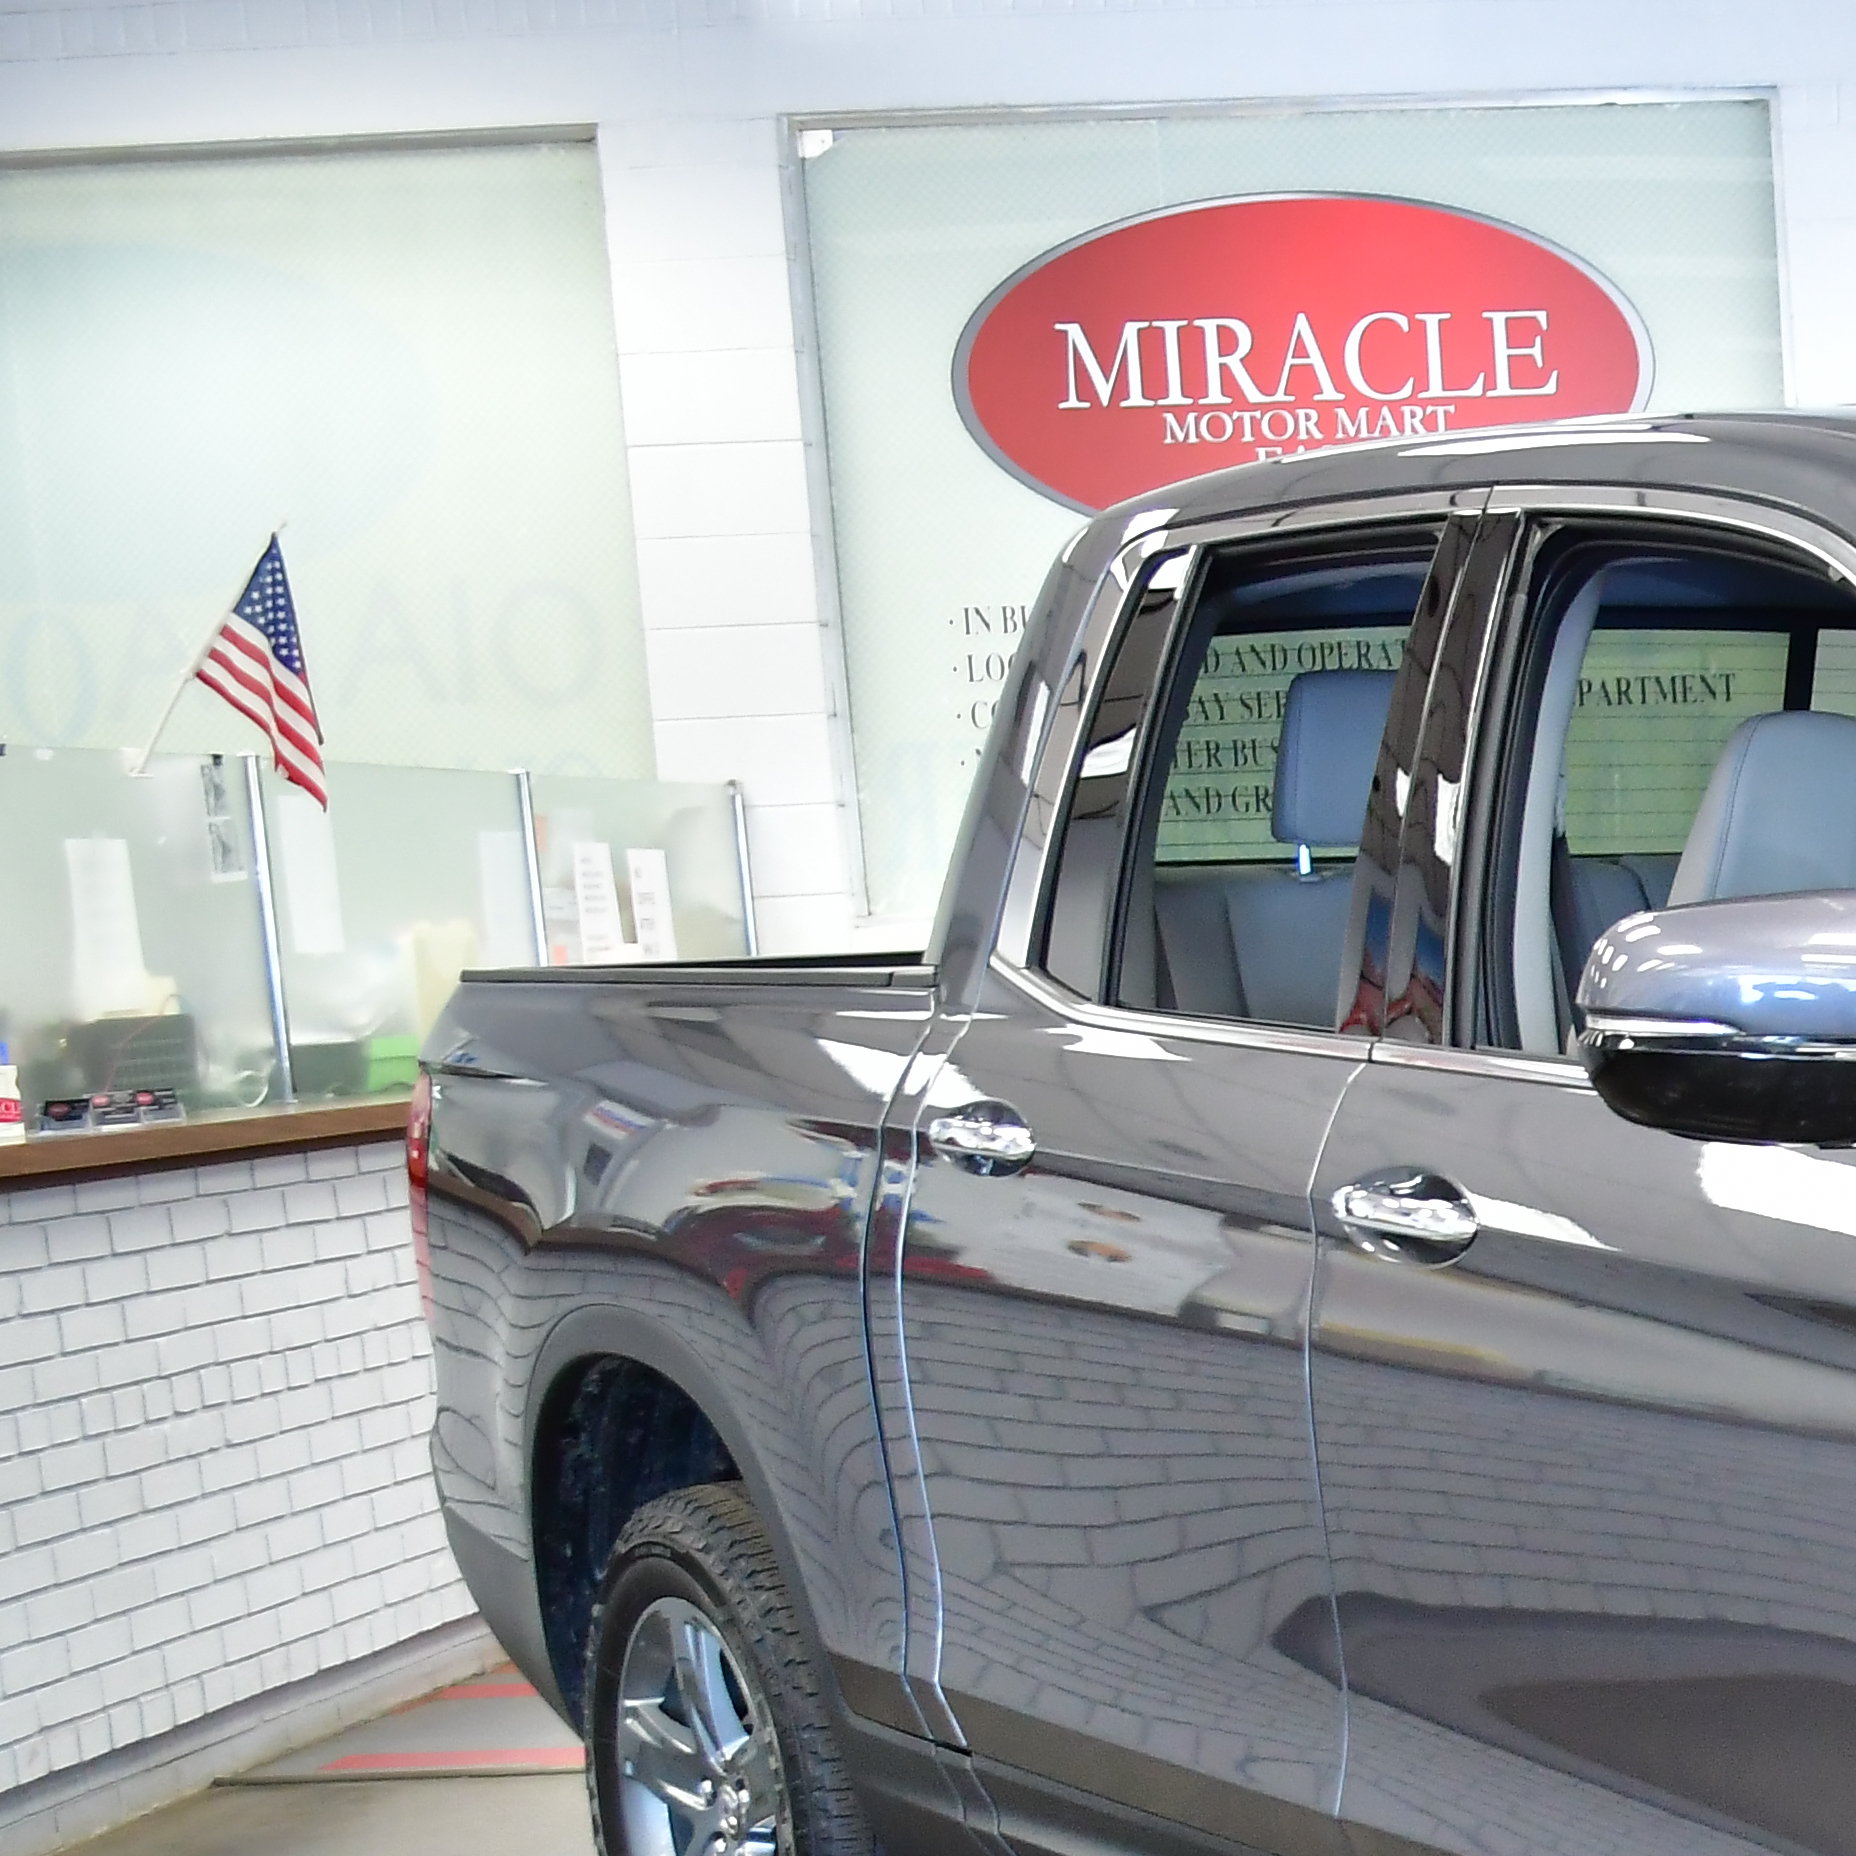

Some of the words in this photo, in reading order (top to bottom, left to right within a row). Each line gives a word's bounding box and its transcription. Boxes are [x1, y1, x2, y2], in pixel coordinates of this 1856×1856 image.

[1053, 309, 1560, 410] MIRACLE
[1162, 408, 1325, 445] MOTOR
[1334, 404, 1457, 439] MART
[962, 606, 992, 636] IN
[1230, 642, 1288, 674] AND
[1296, 637, 1408, 672] OPERAT
[1577, 673, 1736, 707] PARTMENT
[1164, 786, 1223, 817] AND
